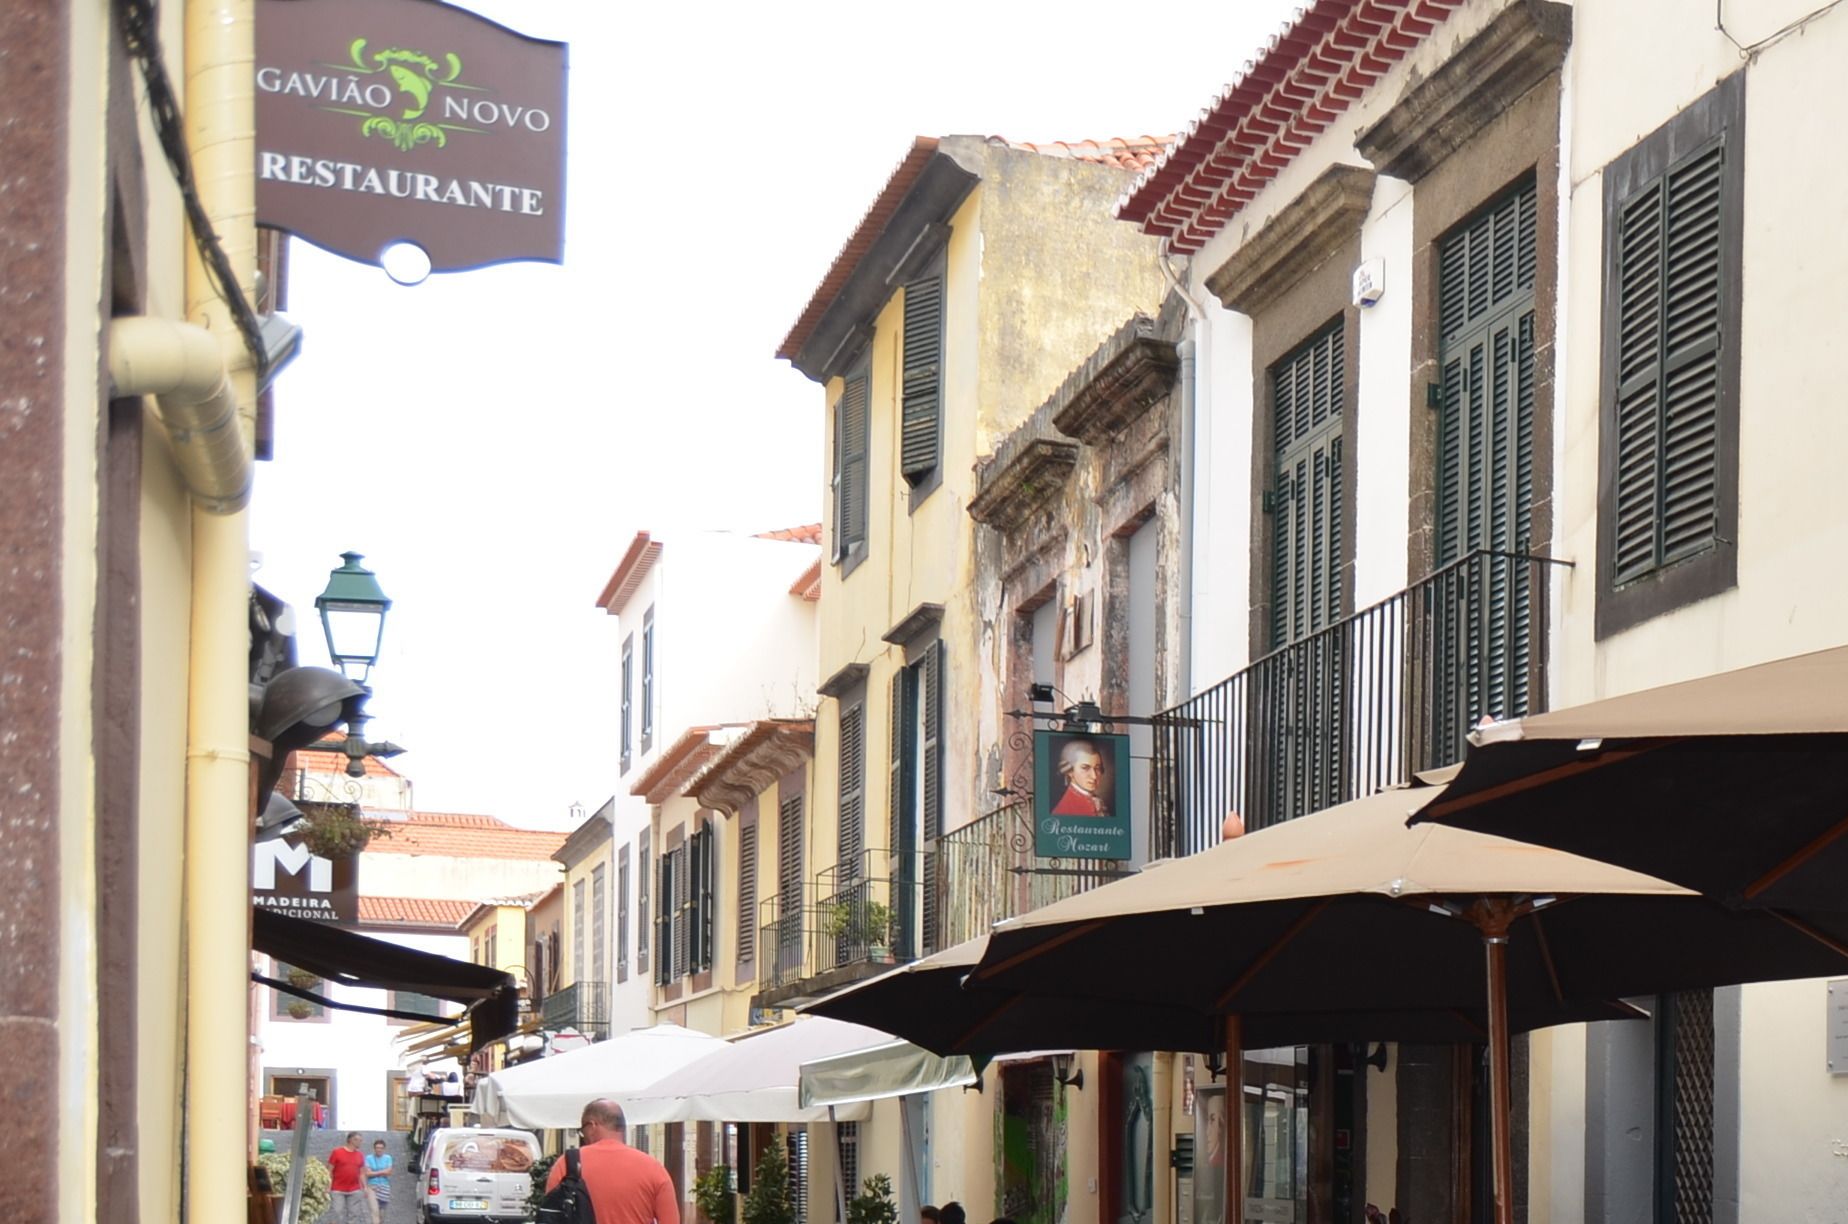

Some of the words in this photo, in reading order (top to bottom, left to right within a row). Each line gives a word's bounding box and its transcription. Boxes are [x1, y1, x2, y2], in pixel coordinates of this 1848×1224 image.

[256, 67, 392, 109] GAVIÃO
[443, 96, 550, 133] NOVO
[260, 151, 544, 216] RESTAURANTE
[1041, 817, 1125, 836] Restaurante
[1057, 835, 1110, 852] Mozart
[253, 895, 332, 909] MADEIRA
